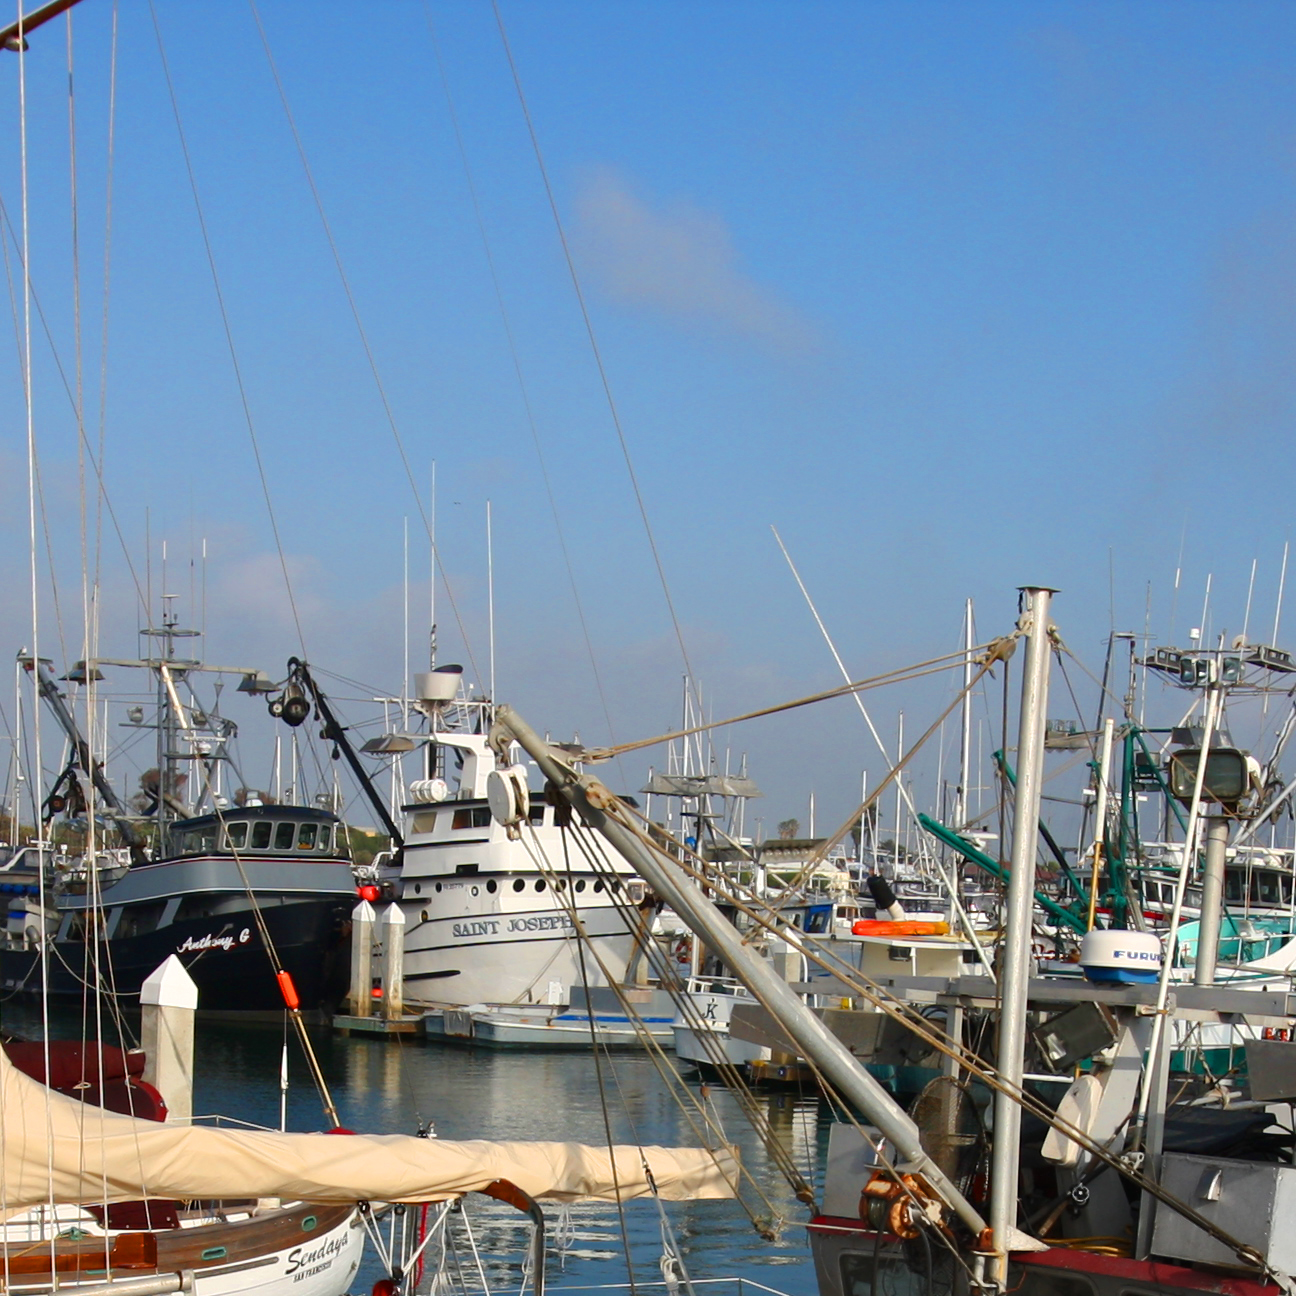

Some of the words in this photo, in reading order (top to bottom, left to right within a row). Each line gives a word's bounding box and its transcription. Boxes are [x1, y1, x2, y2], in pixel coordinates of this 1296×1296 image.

[453, 920, 500, 937] SAINT
[507, 915, 576, 933] JOSEPH
[176, 933, 236, 953] Anthony
[239, 927, 250, 943] G
